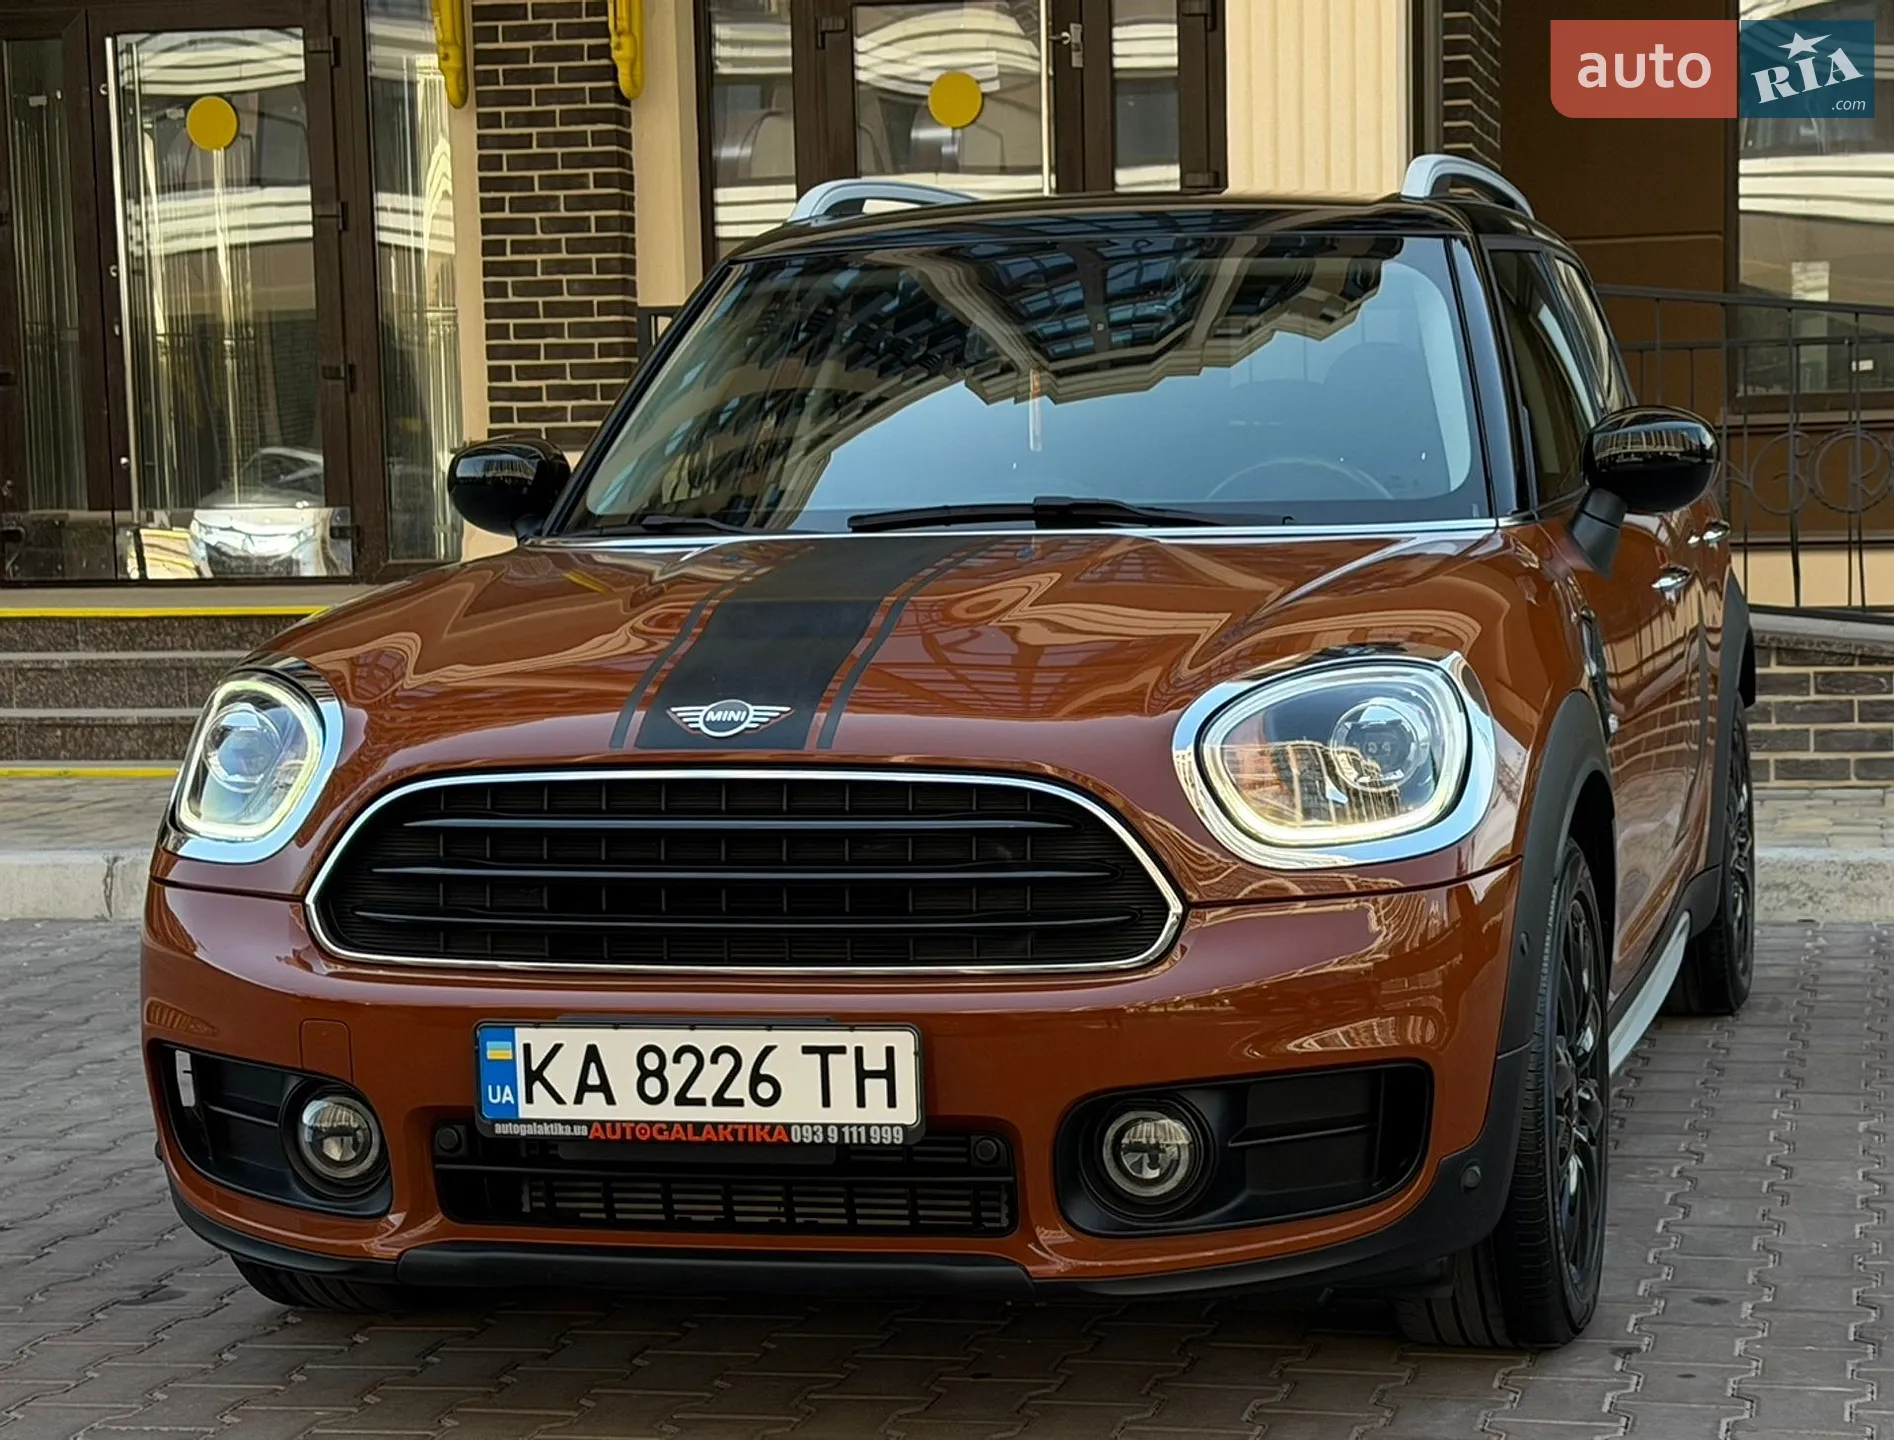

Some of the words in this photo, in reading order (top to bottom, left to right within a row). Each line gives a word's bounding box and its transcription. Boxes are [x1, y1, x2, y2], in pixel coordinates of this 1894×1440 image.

[705, 711, 747, 722] MINI
[523, 1043, 616, 1105] KA
[636, 1044, 782, 1107] 8226
[801, 1045, 897, 1108] TH
[488, 1084, 515, 1104] UA
[494, 1122, 588, 1136] autogalaktika.ua
[589, 1122, 789, 1142] AUTOGALAKTIKA
[791, 1124, 823, 1144] 093
[827, 1125, 839, 1144] 9
[841, 1125, 867, 1145] 111
[869, 1125, 904, 1145] 999
